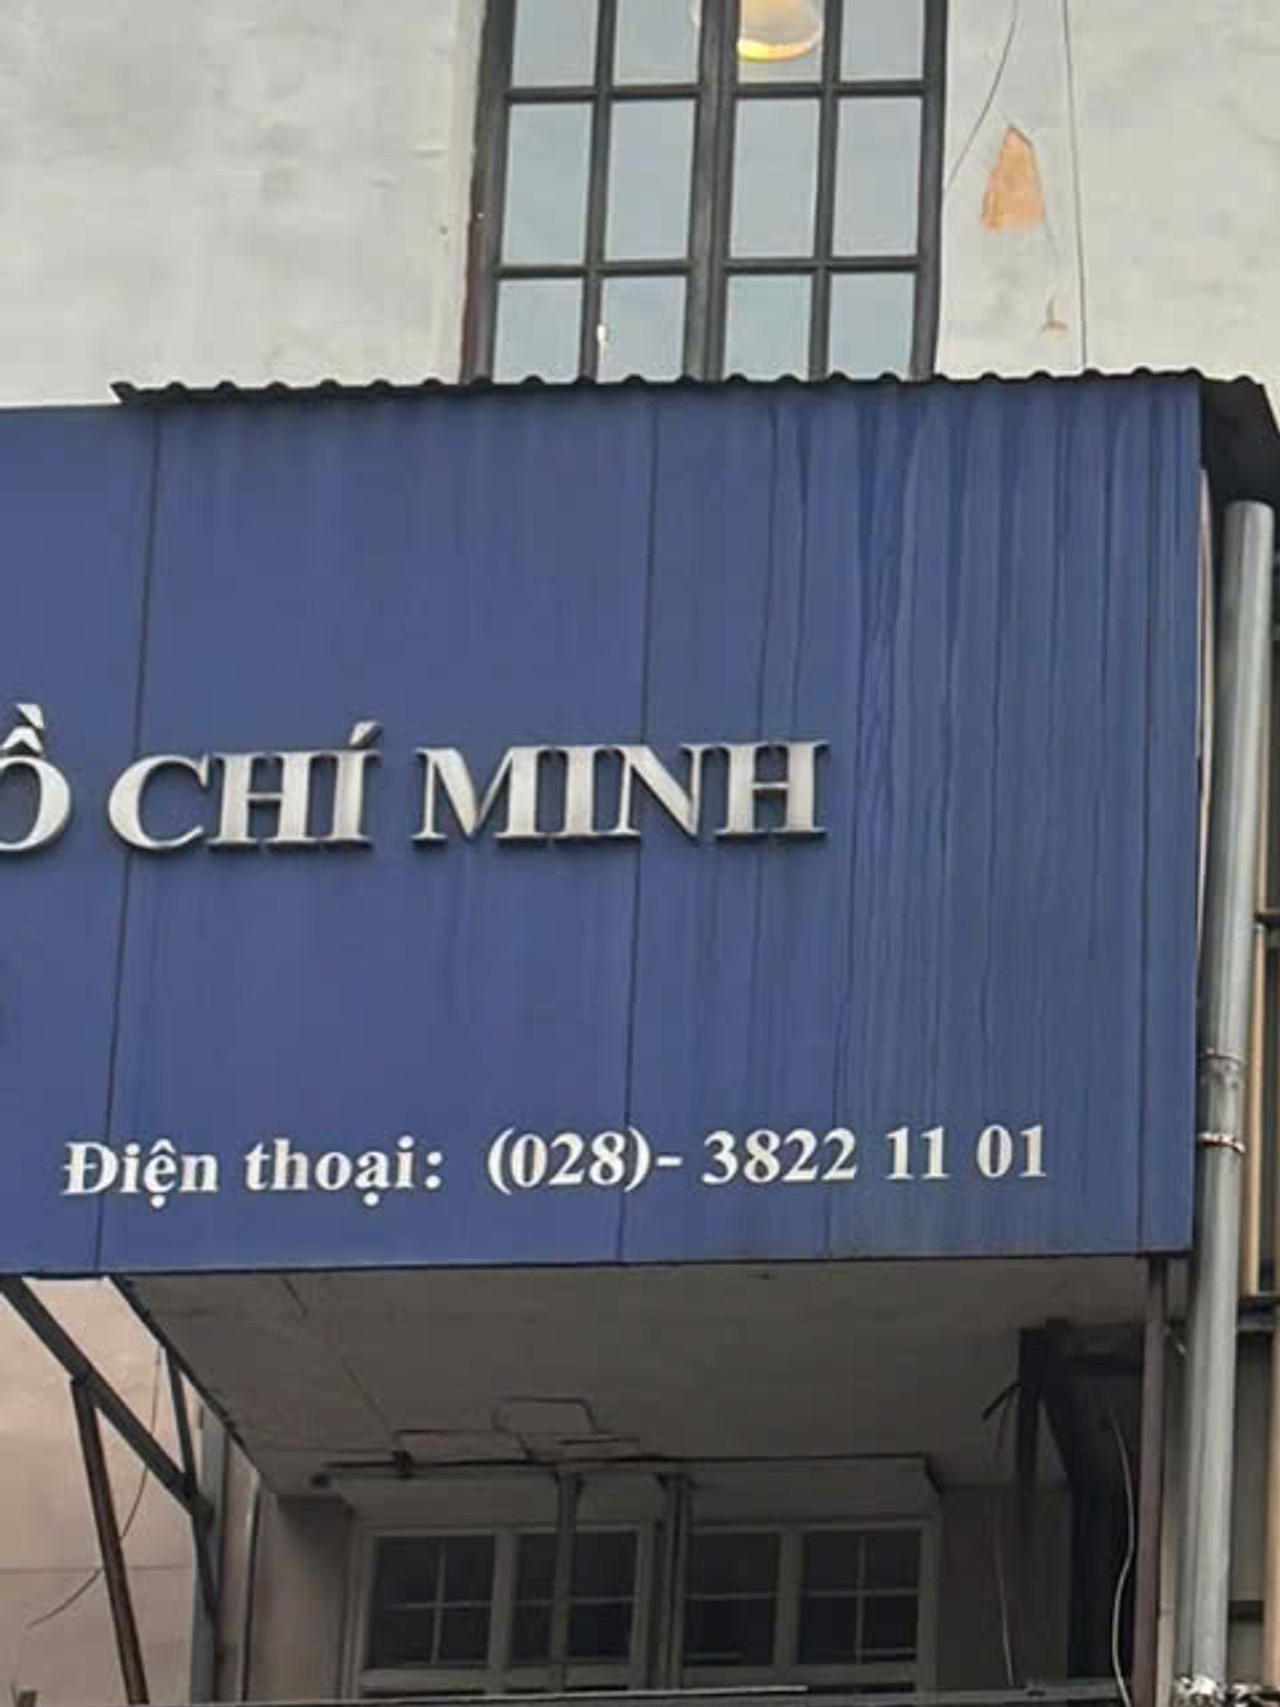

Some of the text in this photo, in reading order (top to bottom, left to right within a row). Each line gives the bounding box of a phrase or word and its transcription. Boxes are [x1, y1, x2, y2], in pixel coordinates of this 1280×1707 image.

[108, 720, 383, 849] CHÍ
[411, 739, 831, 845] MINH
[62, 1123, 1047, 1208] Điện thoại: (028)- 3822 11 01
